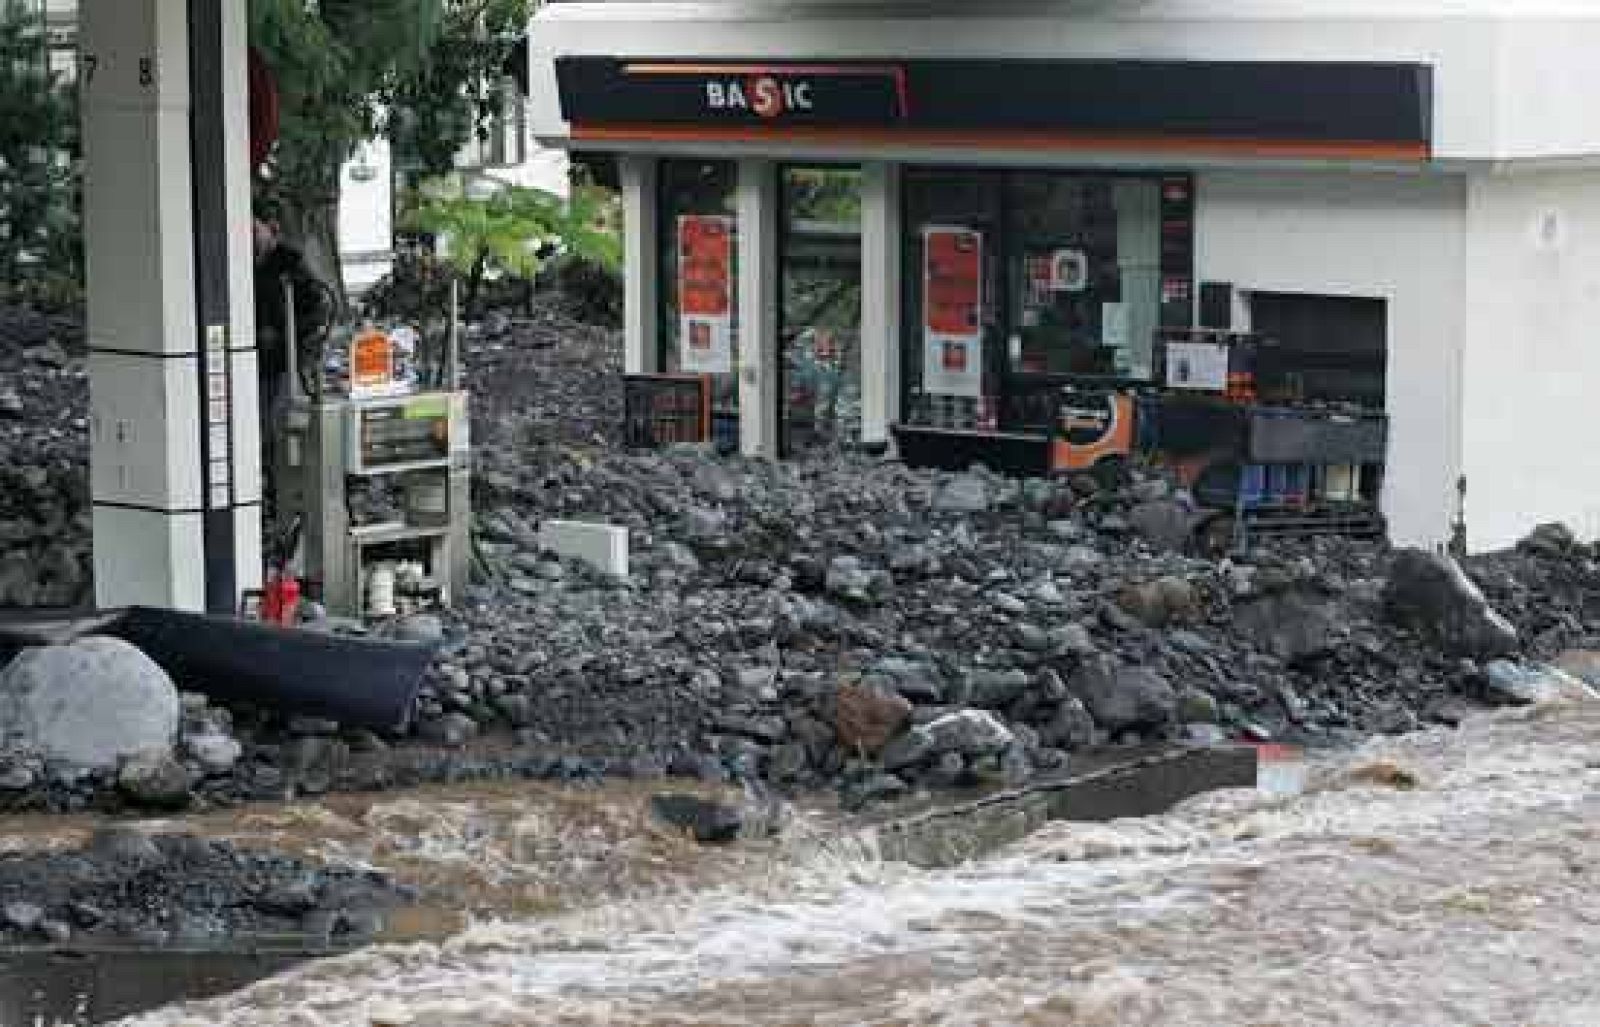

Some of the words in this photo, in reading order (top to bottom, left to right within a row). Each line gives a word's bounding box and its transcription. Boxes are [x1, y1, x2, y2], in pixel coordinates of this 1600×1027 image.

[84, 55, 96, 87] 7
[139, 57, 152, 86] 8
[706, 78, 813, 113] BASIC
